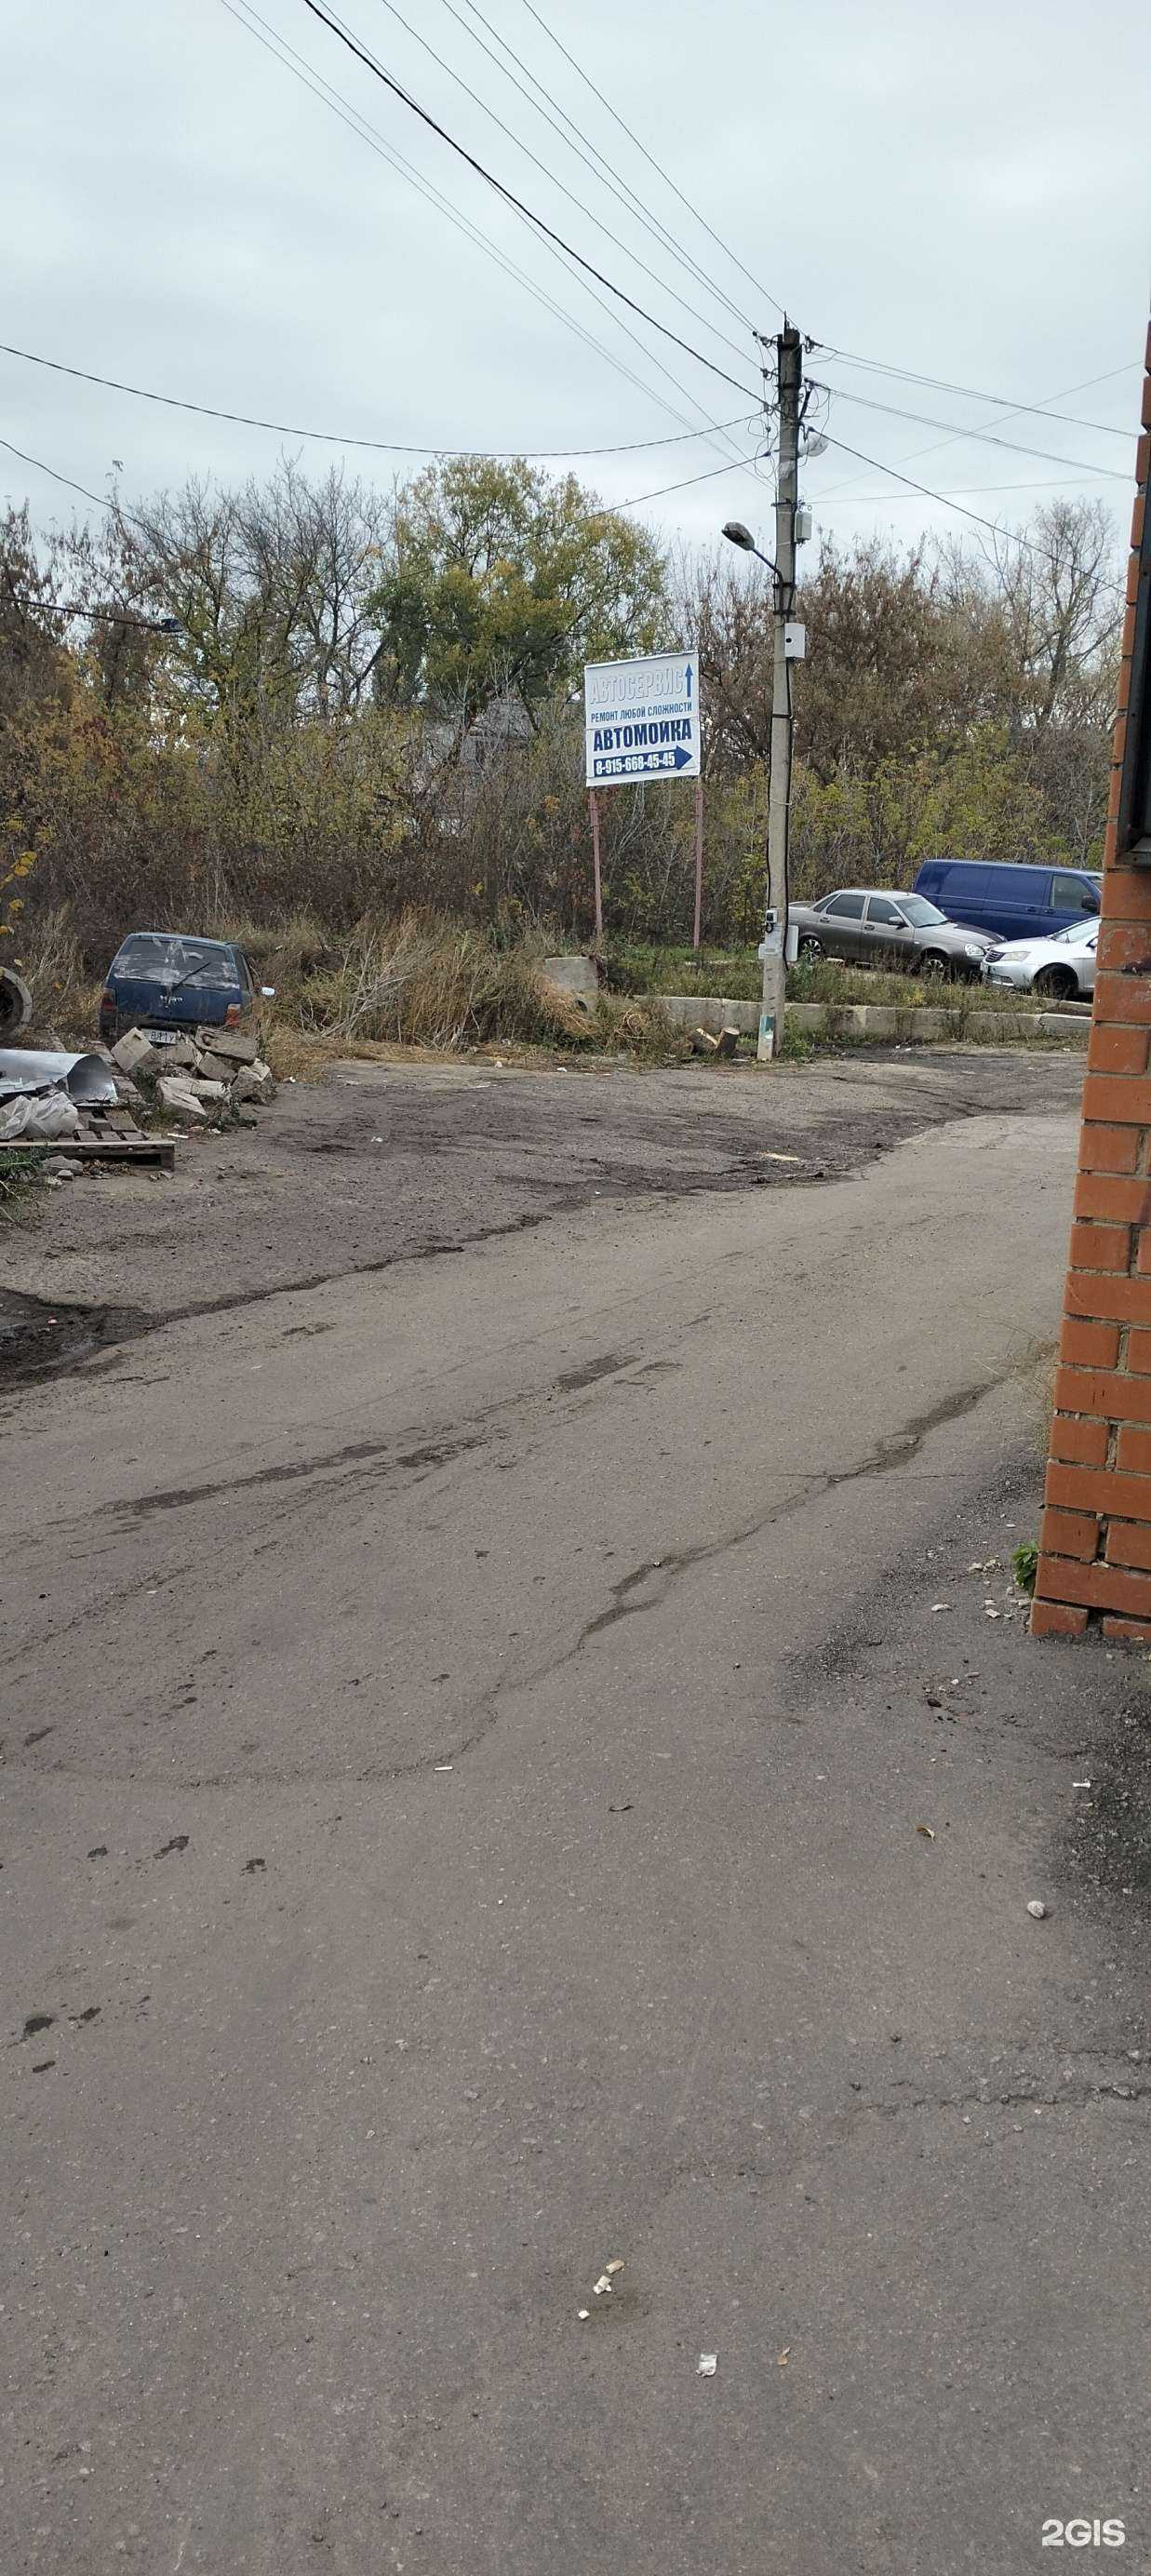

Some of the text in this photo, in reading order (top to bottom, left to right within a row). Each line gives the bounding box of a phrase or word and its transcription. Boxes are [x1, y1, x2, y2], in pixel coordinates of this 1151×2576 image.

[590, 667, 684, 704] АВТОСЕРВИС
[591, 703, 692, 723] РЕМОНТ ЛЮБОЙ СЛОЖНОСТИ
[594, 718, 692, 752] АВТОМОЙКА
[596, 752, 676, 775] 8-915-668-45-45
